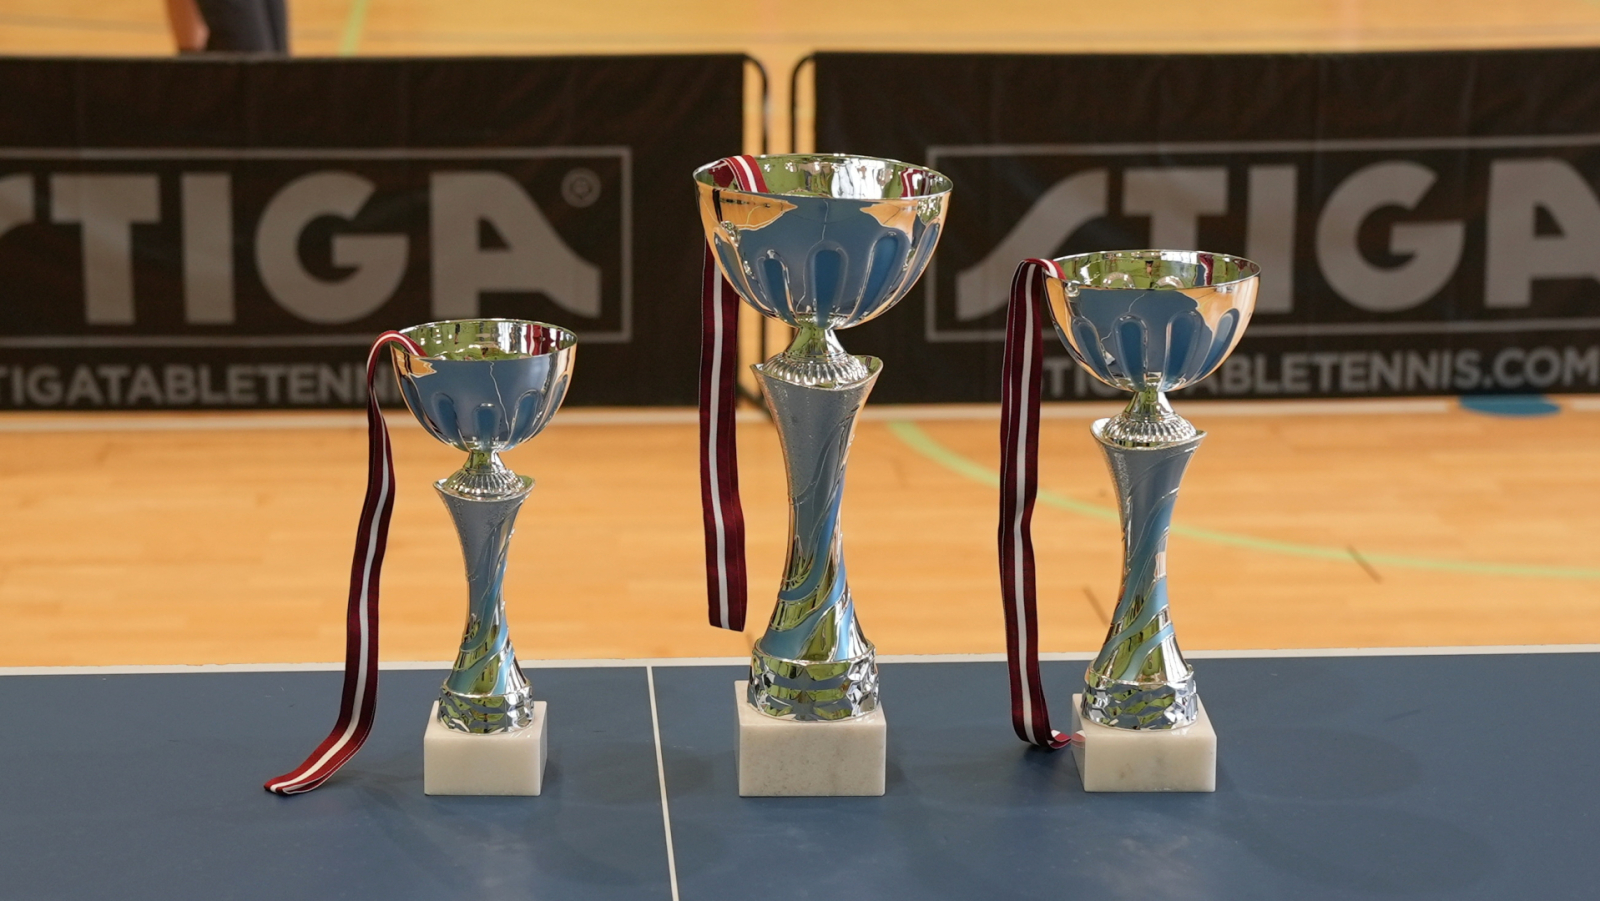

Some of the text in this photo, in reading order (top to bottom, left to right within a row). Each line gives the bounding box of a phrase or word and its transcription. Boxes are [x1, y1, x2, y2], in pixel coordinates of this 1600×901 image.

[0, 171, 600, 324] TIGA
[956, 159, 1600, 319] STIGA
[0, 363, 400, 404] IGATABLETENN
[1042, 346, 1600, 397] TIBLETENNIS.COM
